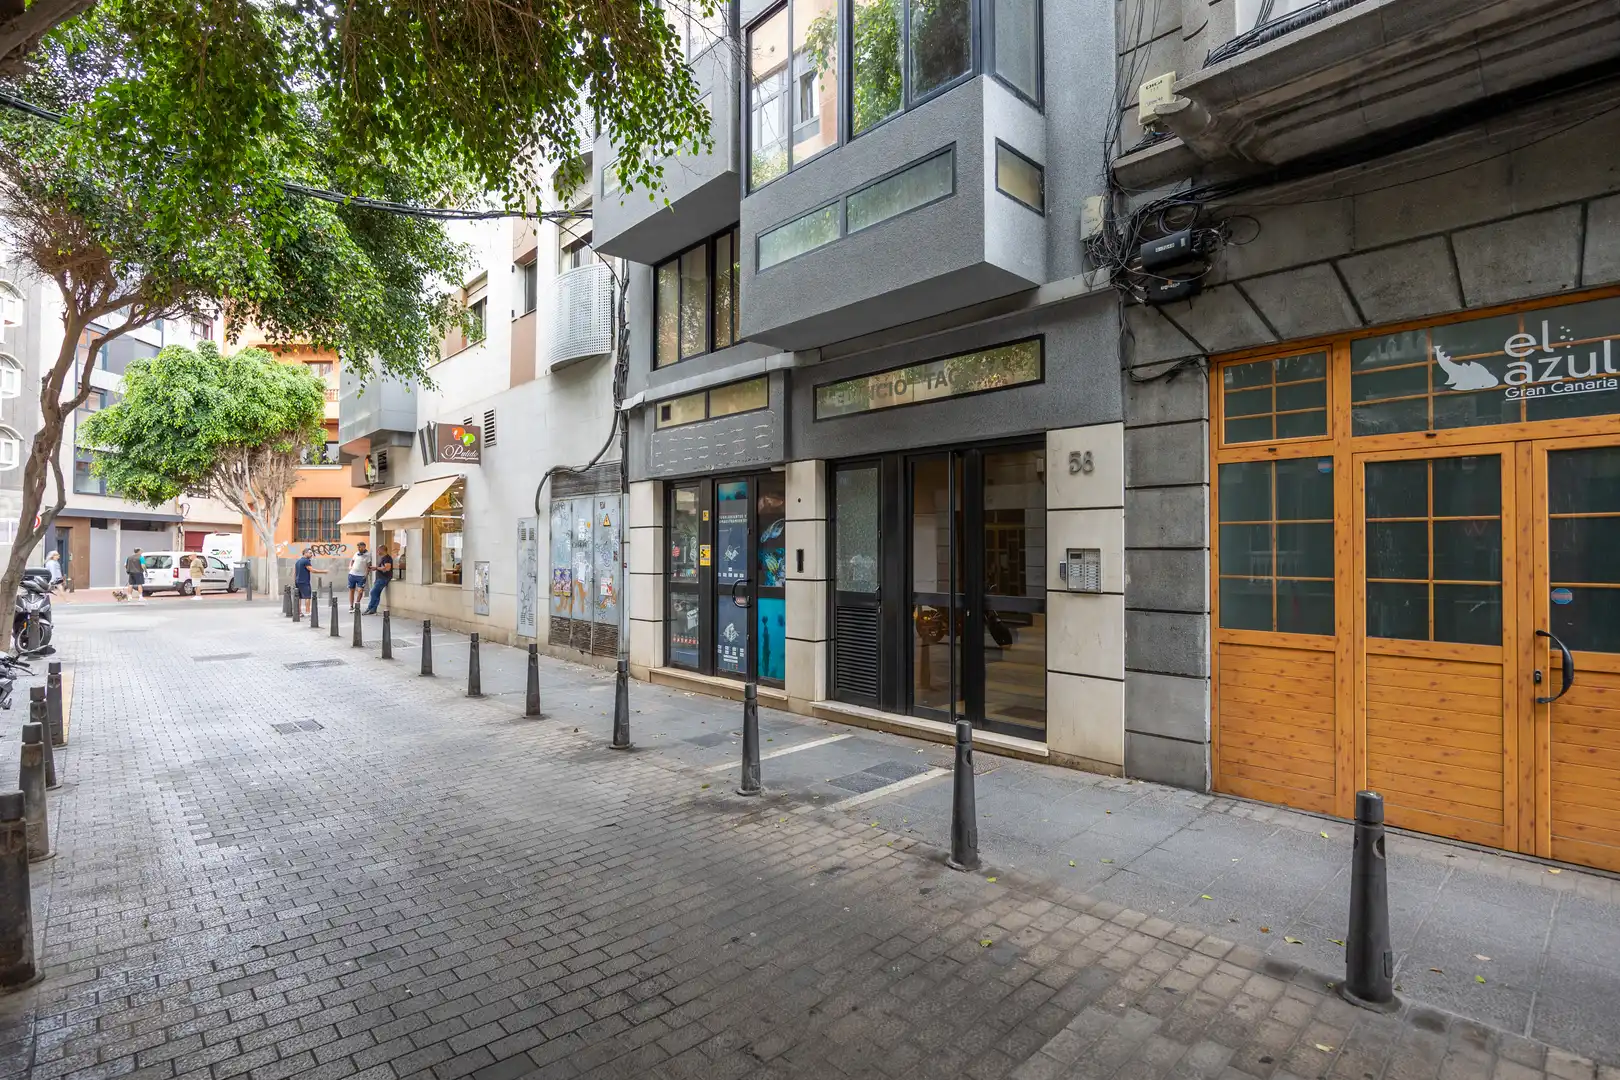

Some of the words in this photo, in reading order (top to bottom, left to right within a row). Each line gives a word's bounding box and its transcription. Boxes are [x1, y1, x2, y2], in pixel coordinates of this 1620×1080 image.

[1504, 320, 1554, 357] el
[1503, 339, 1617, 386] azul
[1504, 386, 1546, 399] Gran
[1550, 377, 1619, 393] Canaria
[1069, 451, 1094, 475] 58
